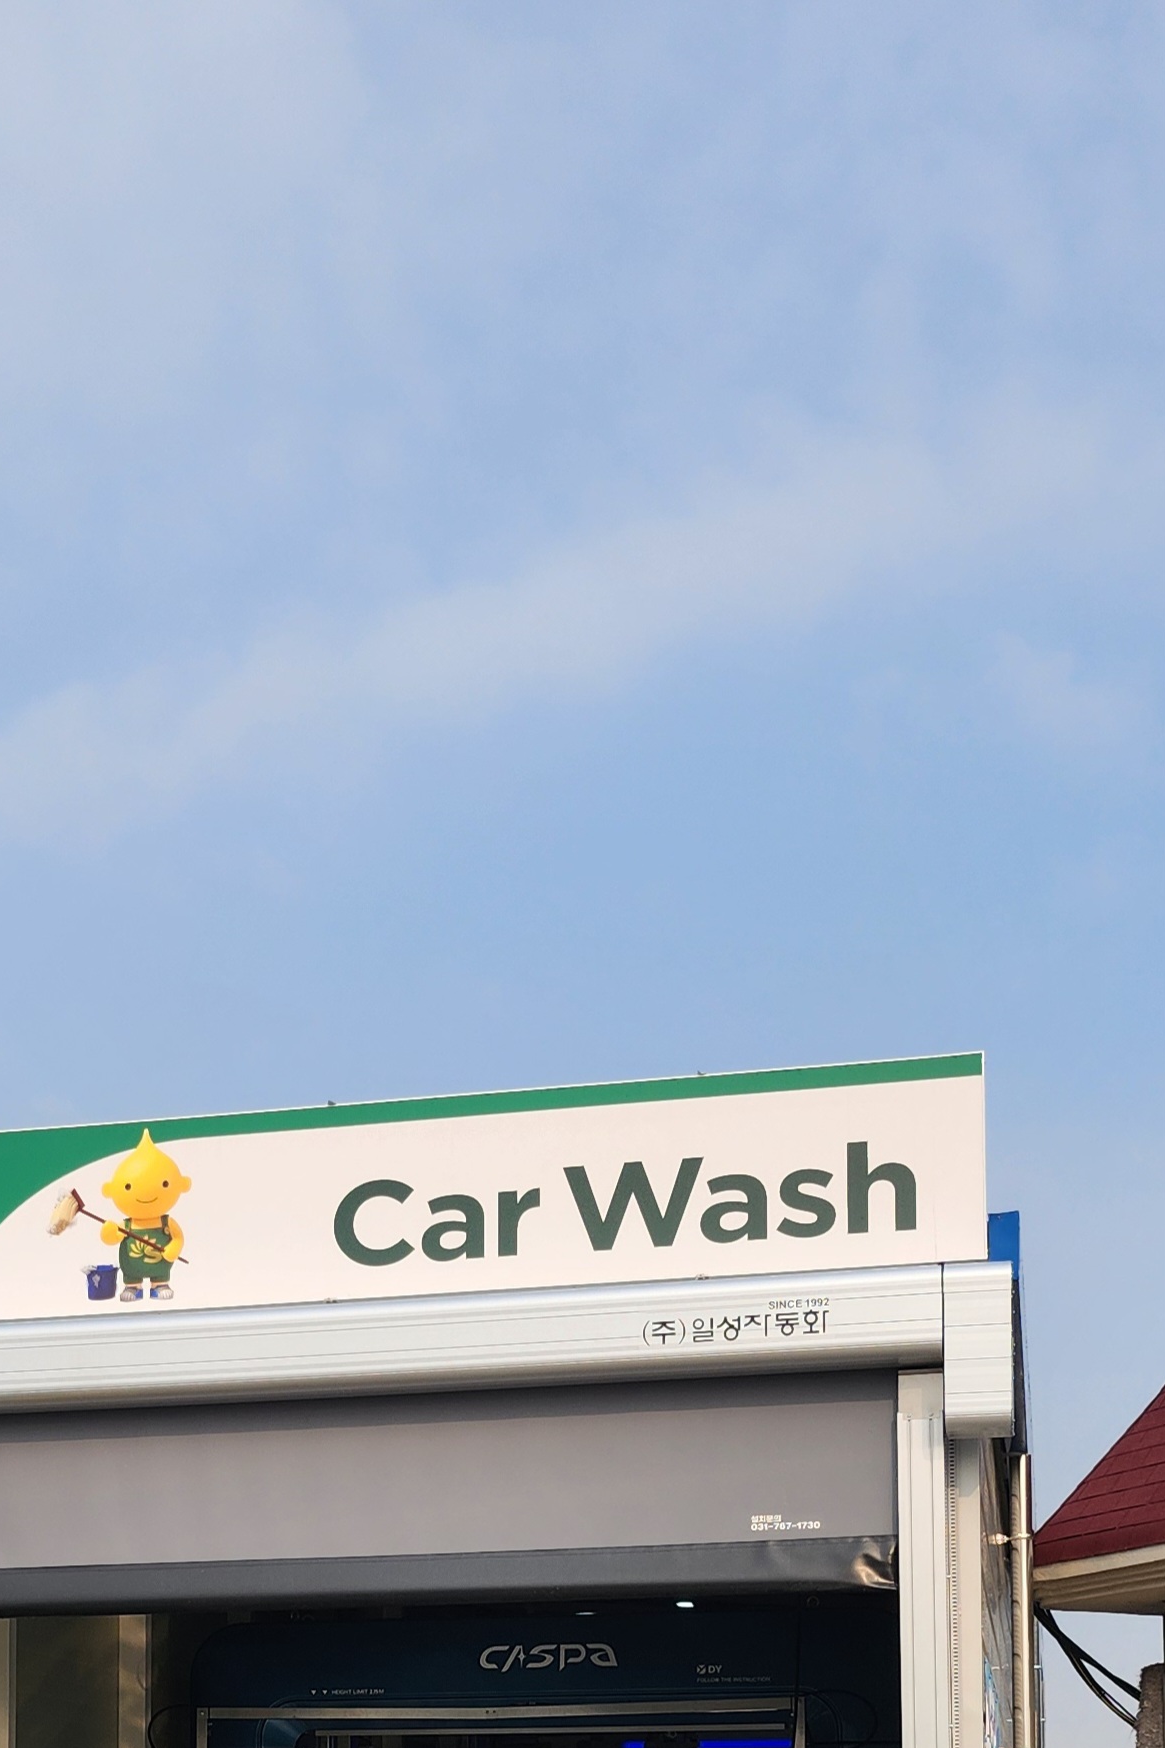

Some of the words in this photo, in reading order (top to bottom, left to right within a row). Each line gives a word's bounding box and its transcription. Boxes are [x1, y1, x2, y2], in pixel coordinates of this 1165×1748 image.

[334, 1180, 540, 1266] Car
[564, 1141, 917, 1251] Wash
[768, 1299, 801, 1310] SINCE
[805, 1297, 829, 1307] 1992
[642, 1319, 686, 1347] (주)
[750, 1514, 781, 1523] 설치문의
[750, 1520, 821, 1531] 031-767-1730
